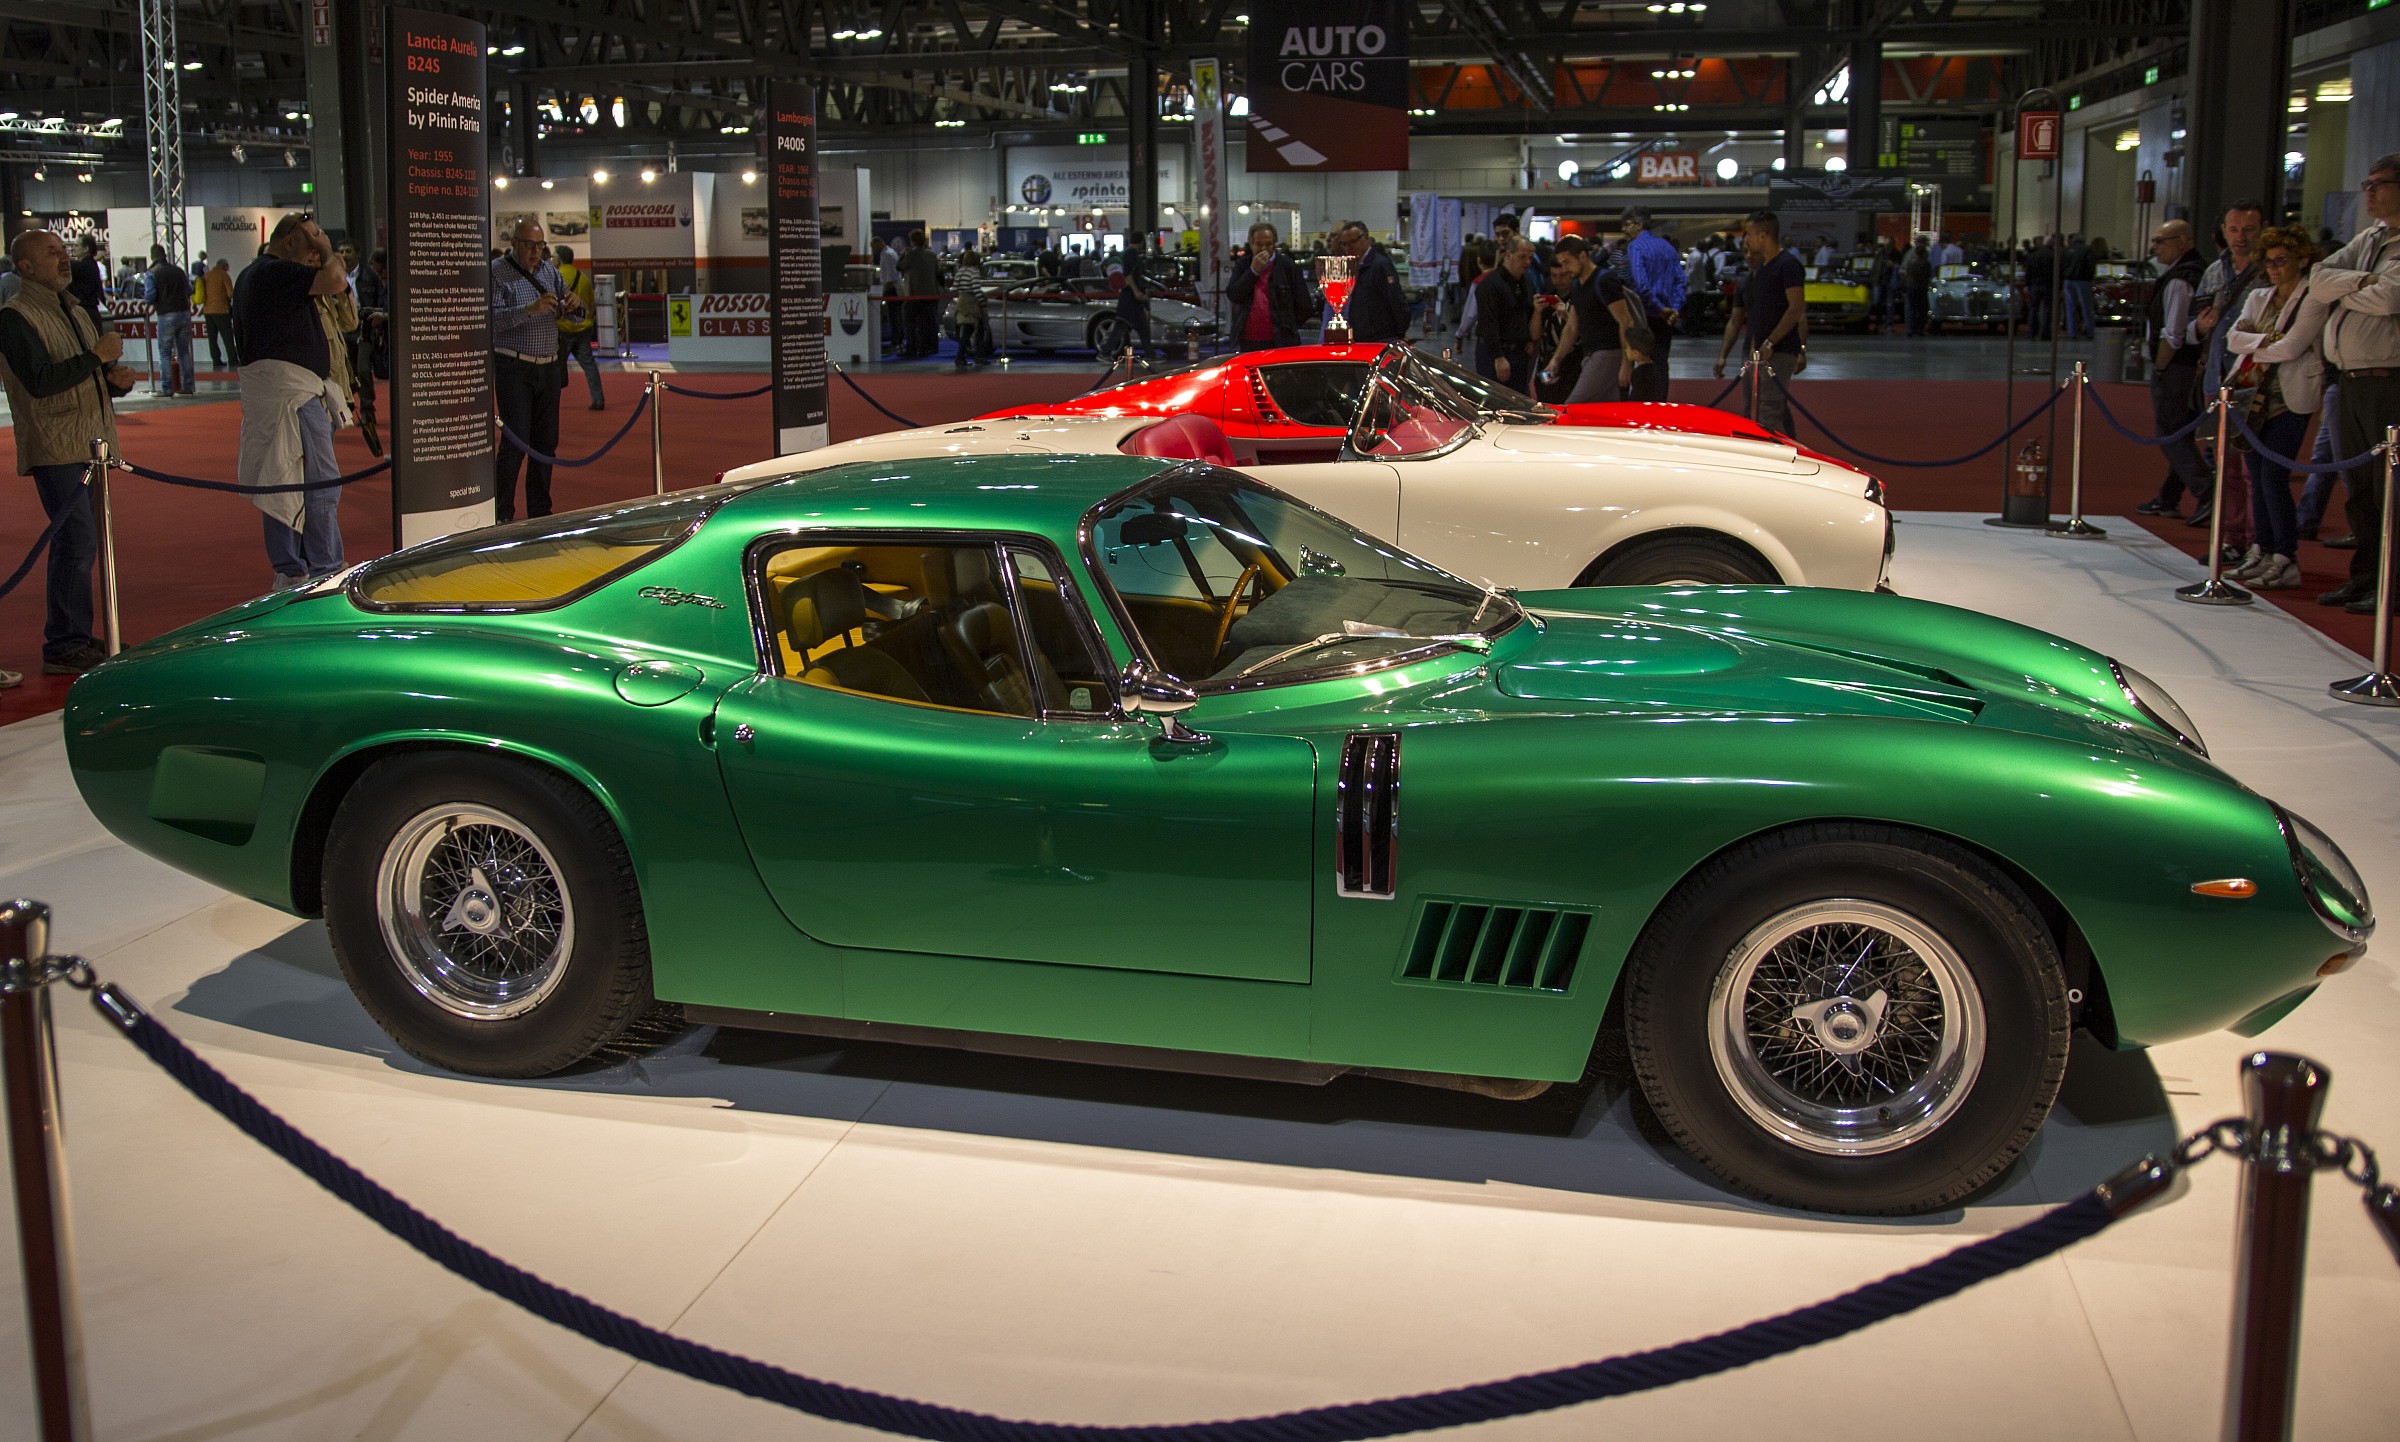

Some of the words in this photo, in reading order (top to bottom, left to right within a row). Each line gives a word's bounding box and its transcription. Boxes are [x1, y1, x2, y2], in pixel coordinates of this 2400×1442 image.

[407, 32, 447, 51] Lancia
[450, 38, 478, 58] Aurelia
[1280, 24, 1386, 56] AUTO
[407, 55, 440, 73] B24S
[1281, 61, 1366, 92] CARS
[407, 87, 449, 106] Spider
[451, 91, 480, 110] America
[408, 109, 425, 129] by
[428, 112, 457, 129] Pinin
[460, 115, 480, 132] Farina
[777, 136, 805, 152] P400S
[408, 149, 431, 161] Year:
[433, 150, 453, 162] 1955
[408, 165, 444, 178] Chassis:
[1641, 156, 1695, 178] BAR
[409, 183, 439, 196] Engine
[441, 185, 453, 196] no.
[1071, 183, 1126, 199] sprinta
[607, 204, 676, 215] ROSSOCORSA
[49, 217, 95, 231] MILANO
[211, 222, 257, 231] AUTOCLASSICA
[1073, 215, 1093, 231] 18
[1097, 215, 1111, 231] A
